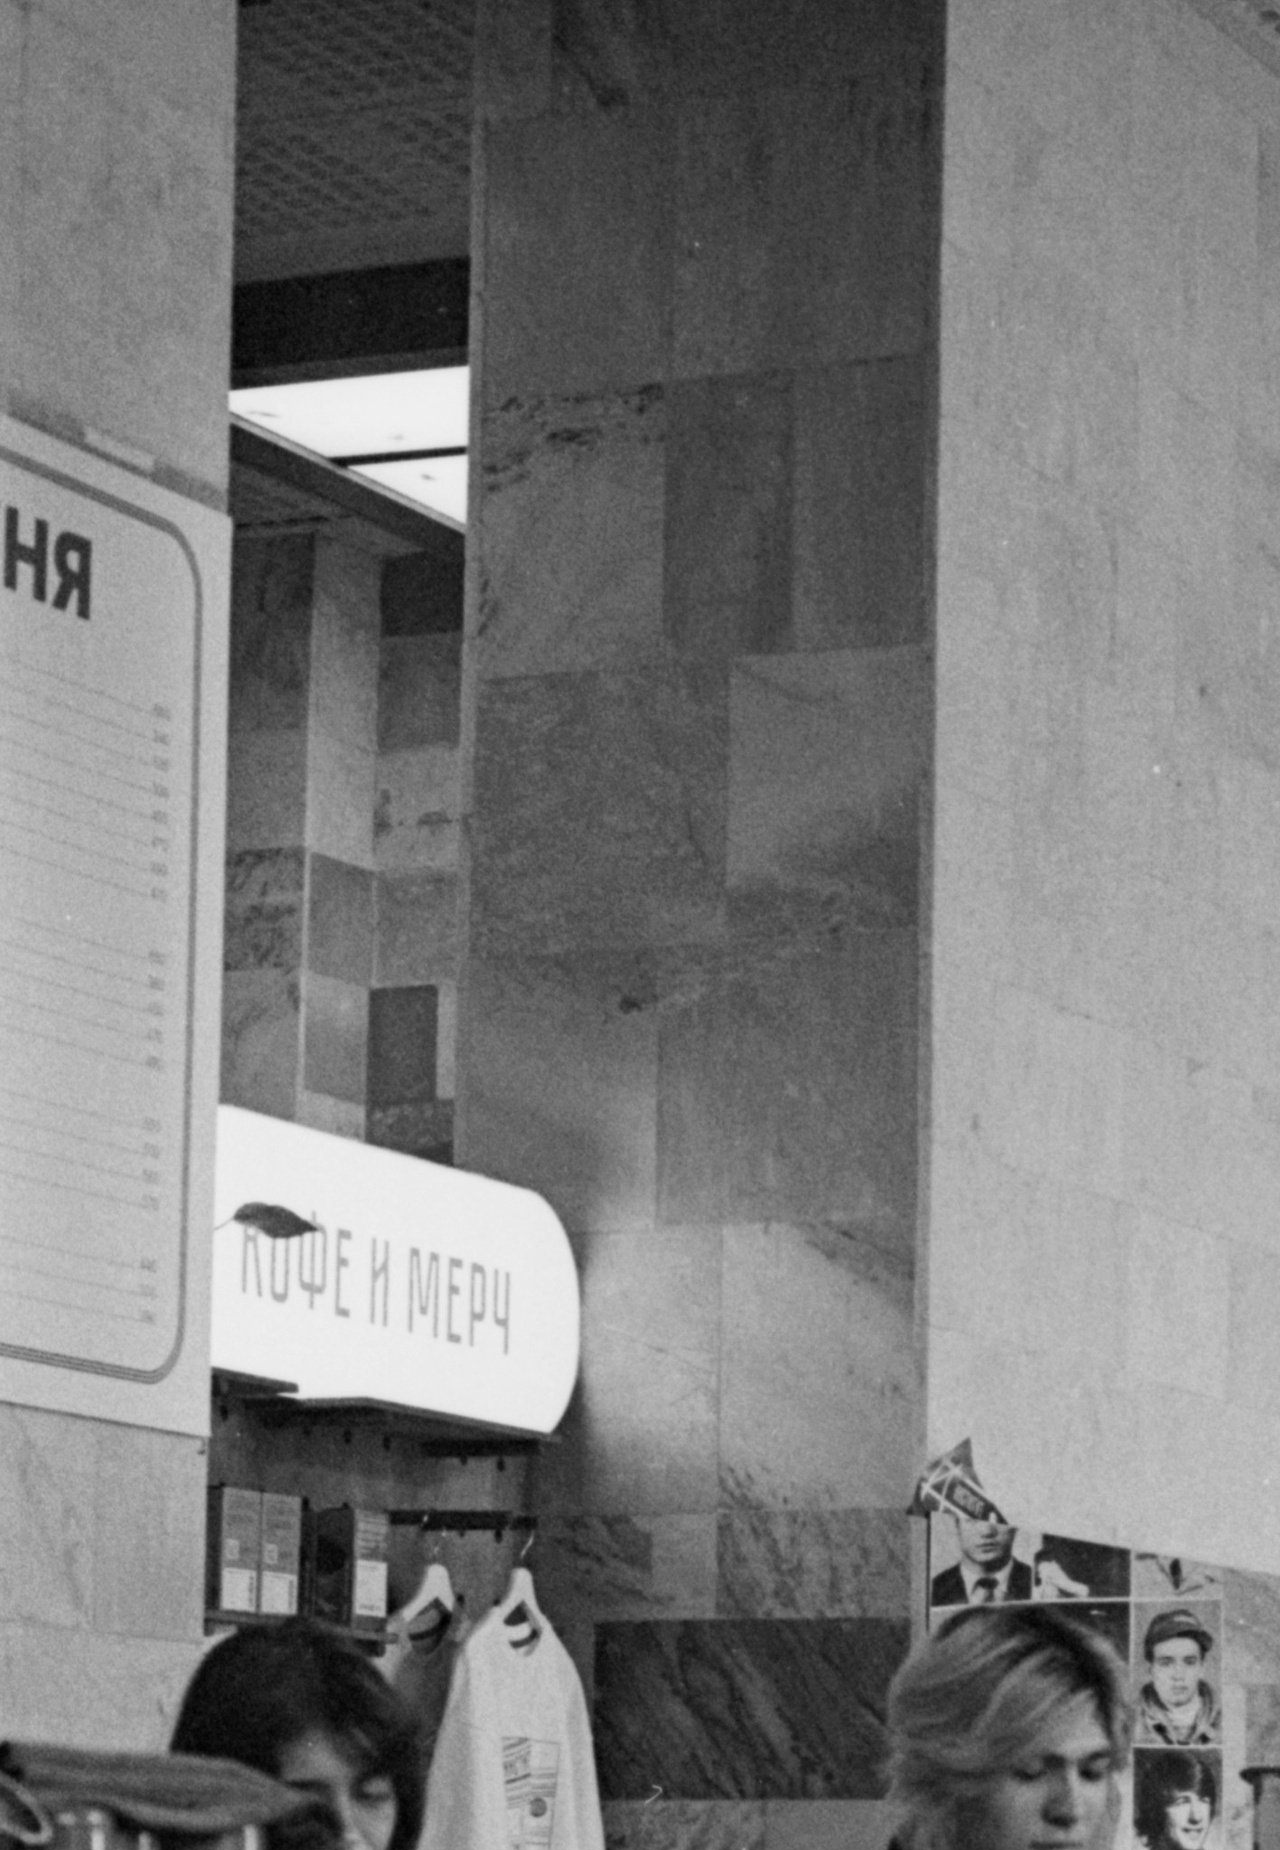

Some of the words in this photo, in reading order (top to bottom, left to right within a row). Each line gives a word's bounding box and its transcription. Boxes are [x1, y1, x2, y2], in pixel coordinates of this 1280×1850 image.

[242, 1210, 352, 1318] КОФЕ
[370, 1237, 389, 1328] И
[408, 1247, 511, 1356] МЕРЧ
